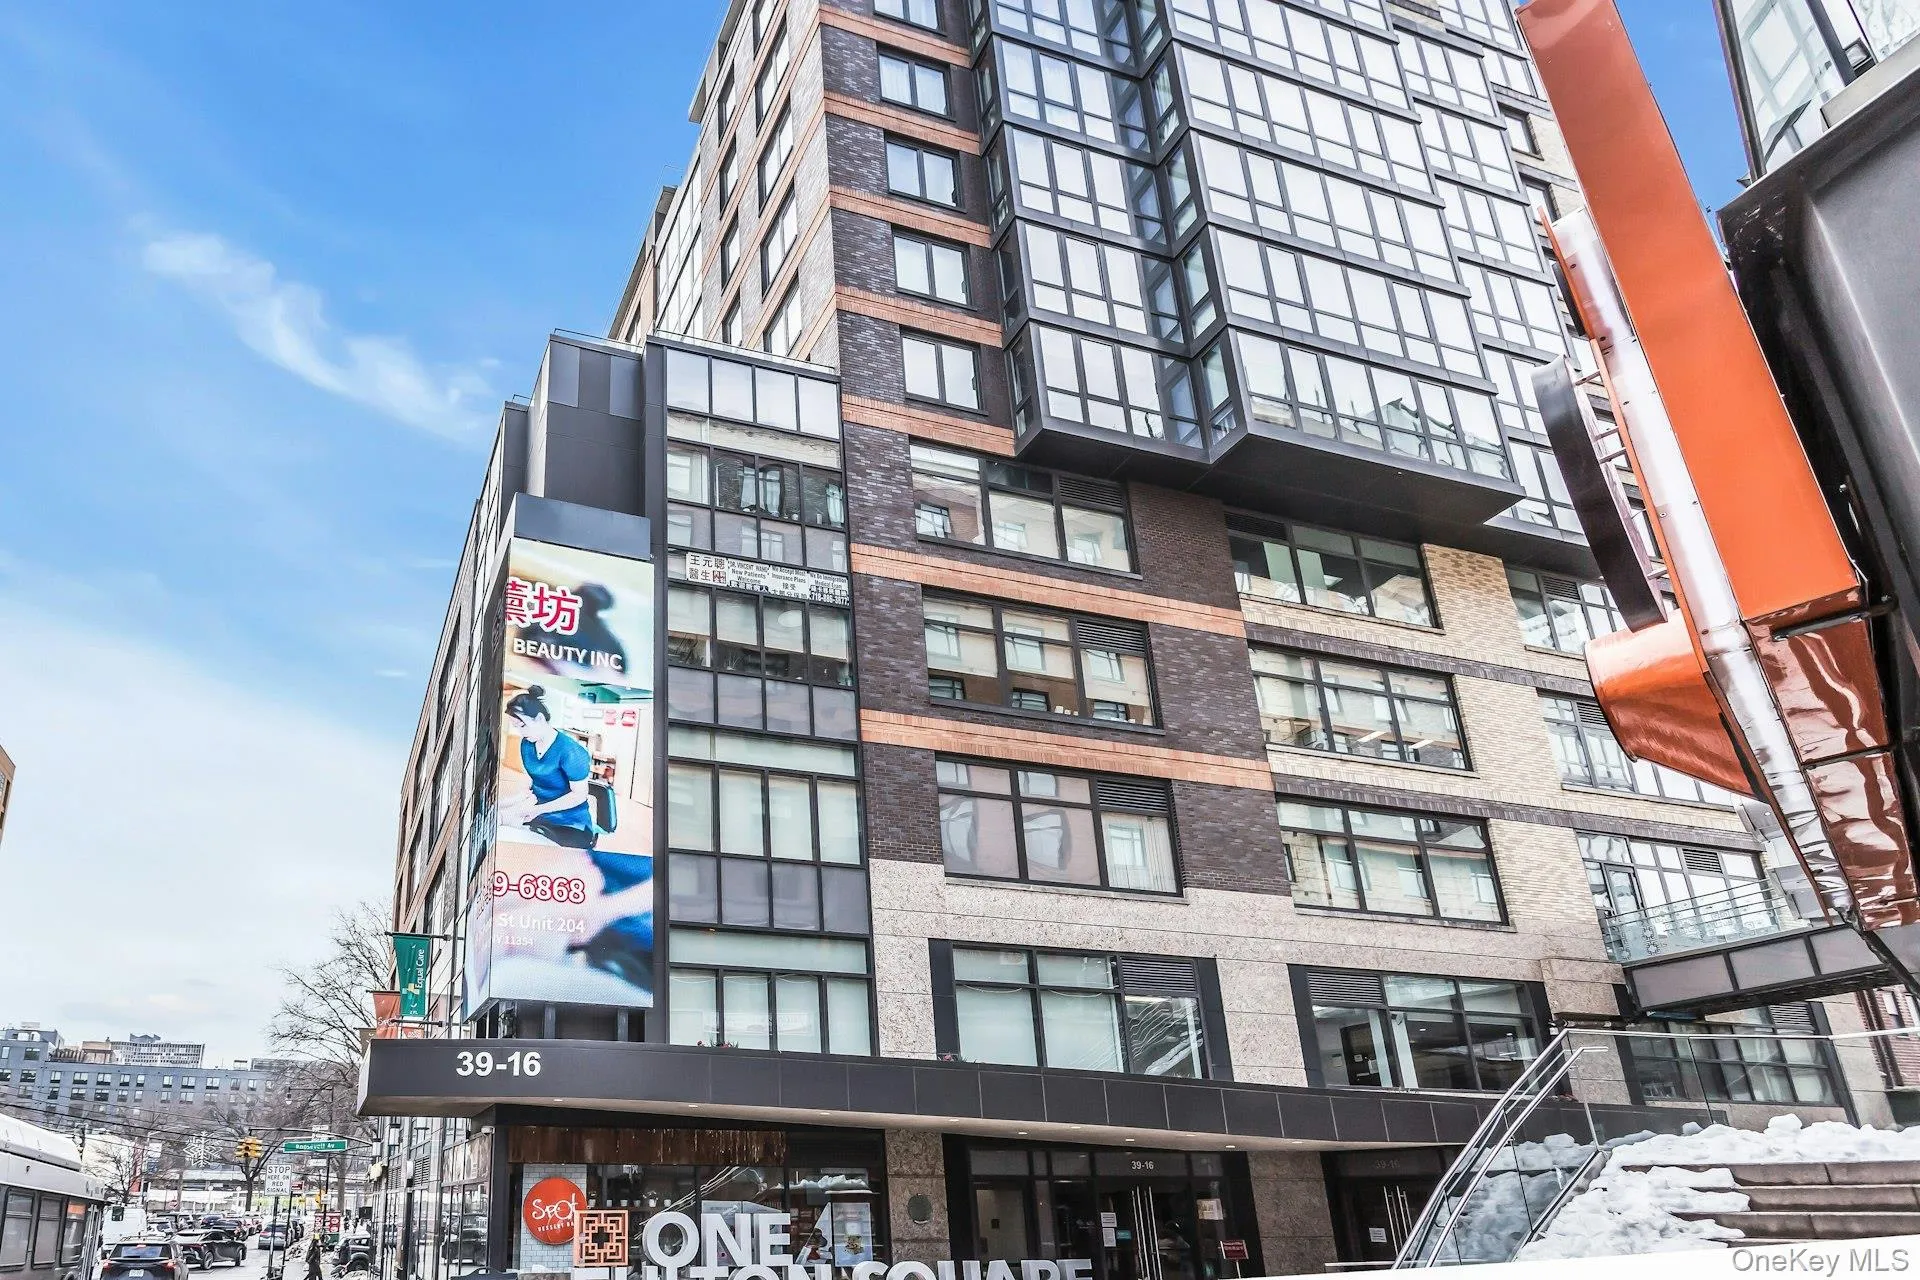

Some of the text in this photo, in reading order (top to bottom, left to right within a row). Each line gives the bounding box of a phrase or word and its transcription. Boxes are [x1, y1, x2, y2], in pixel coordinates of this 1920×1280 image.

[737, 561, 754, 571] VINCENT
[779, 566, 794, 576] Accept
[731, 568, 767, 580] New Patients
[737, 575, 761, 584] Welcome
[771, 572, 806, 584] Insurance Plans
[823, 574, 847, 584] Immigration
[814, 579, 831, 588] Medical
[513, 637, 623, 670] BEAUTY INC
[494, 870, 586, 905] 9-6868
[497, 913, 585, 934] St Unit 204
[415, 949, 425, 988] Equal Care
[456, 1051, 541, 1077] 39-16
[268, 1166, 291, 1174] STOP
[1131, 1160, 1154, 1170] 39-16
[537, 1223, 564, 1232] DESSERT
[643, 1211, 793, 1268] ONE
